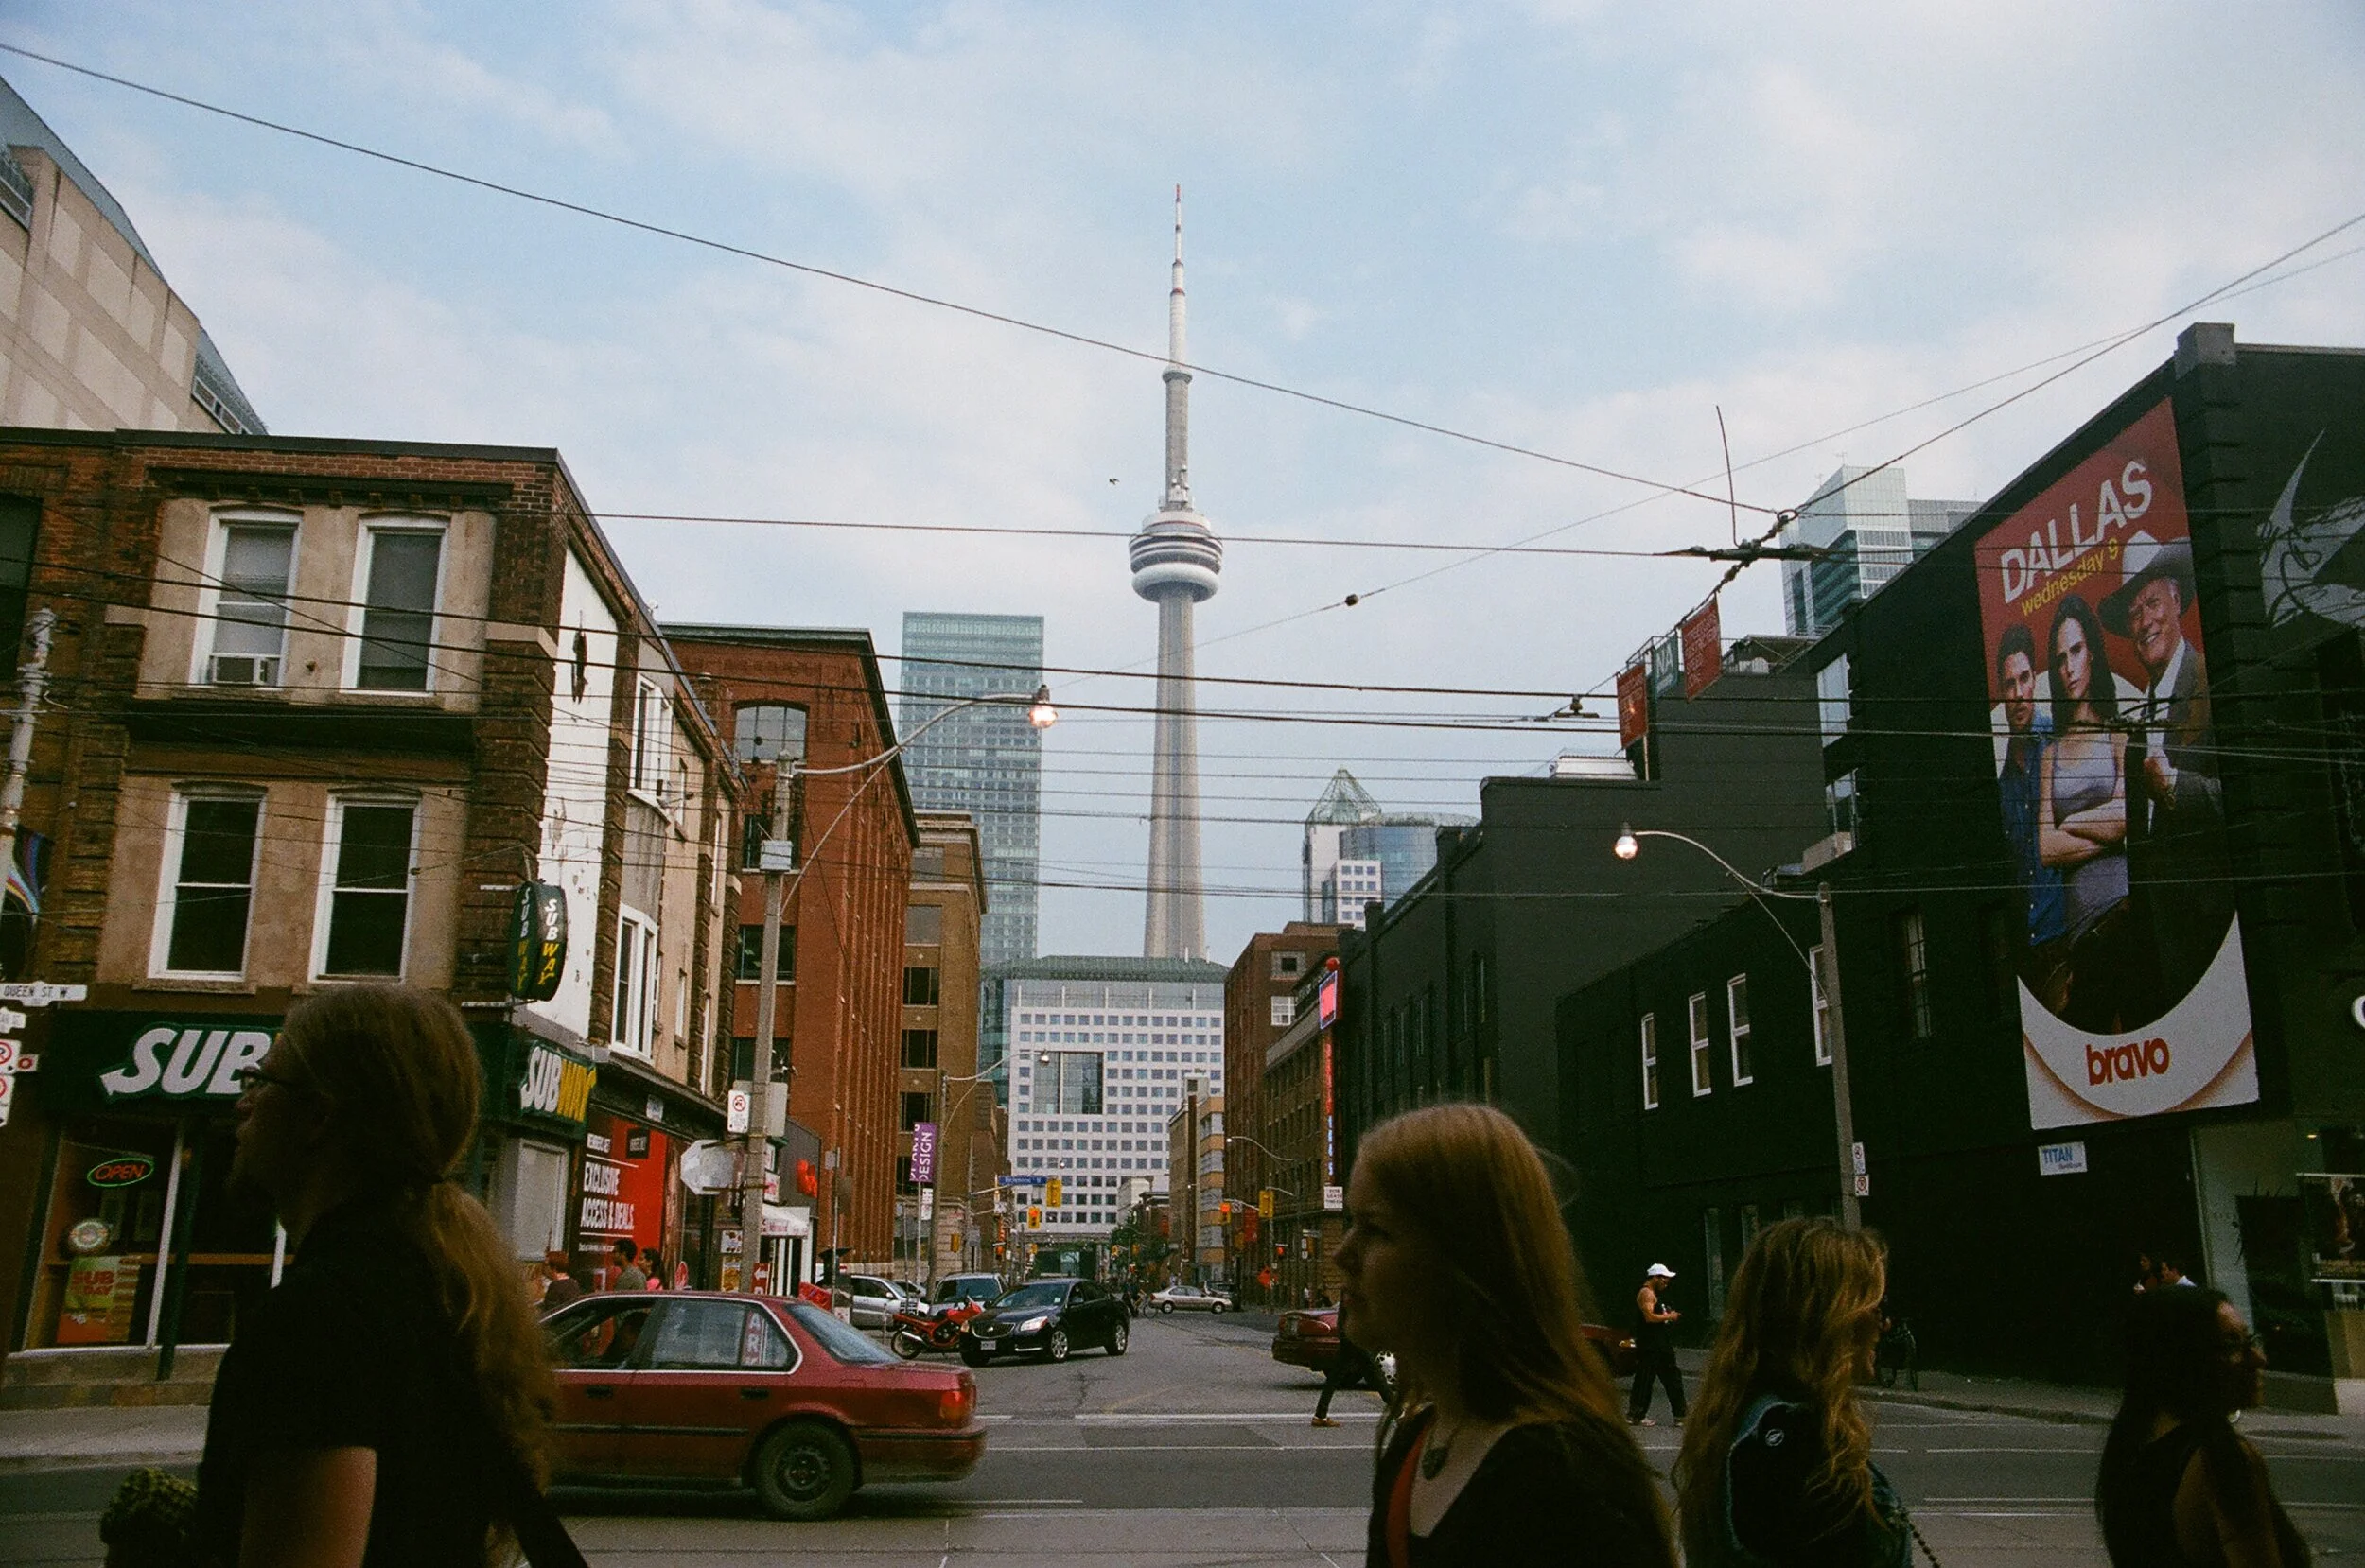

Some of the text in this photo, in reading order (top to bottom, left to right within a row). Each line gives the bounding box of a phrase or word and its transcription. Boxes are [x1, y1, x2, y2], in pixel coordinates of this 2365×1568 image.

[2000, 461, 2152, 604] DALLAS
[2021, 537, 2120, 617] wednesday 9
[517, 887, 531, 992] SUBWAY
[536, 897, 560, 986] SUBWAY
[4, 985, 35, 997] QUEEN
[41, 986, 54, 998] ST
[99, 1027, 281, 1096] SUB
[520, 1045, 598, 1124] SUBWAY
[2086, 1038, 2169, 1085] bravo
[95, 1164, 146, 1181] OPEN
[2042, 1147, 2073, 1163] TITAN
